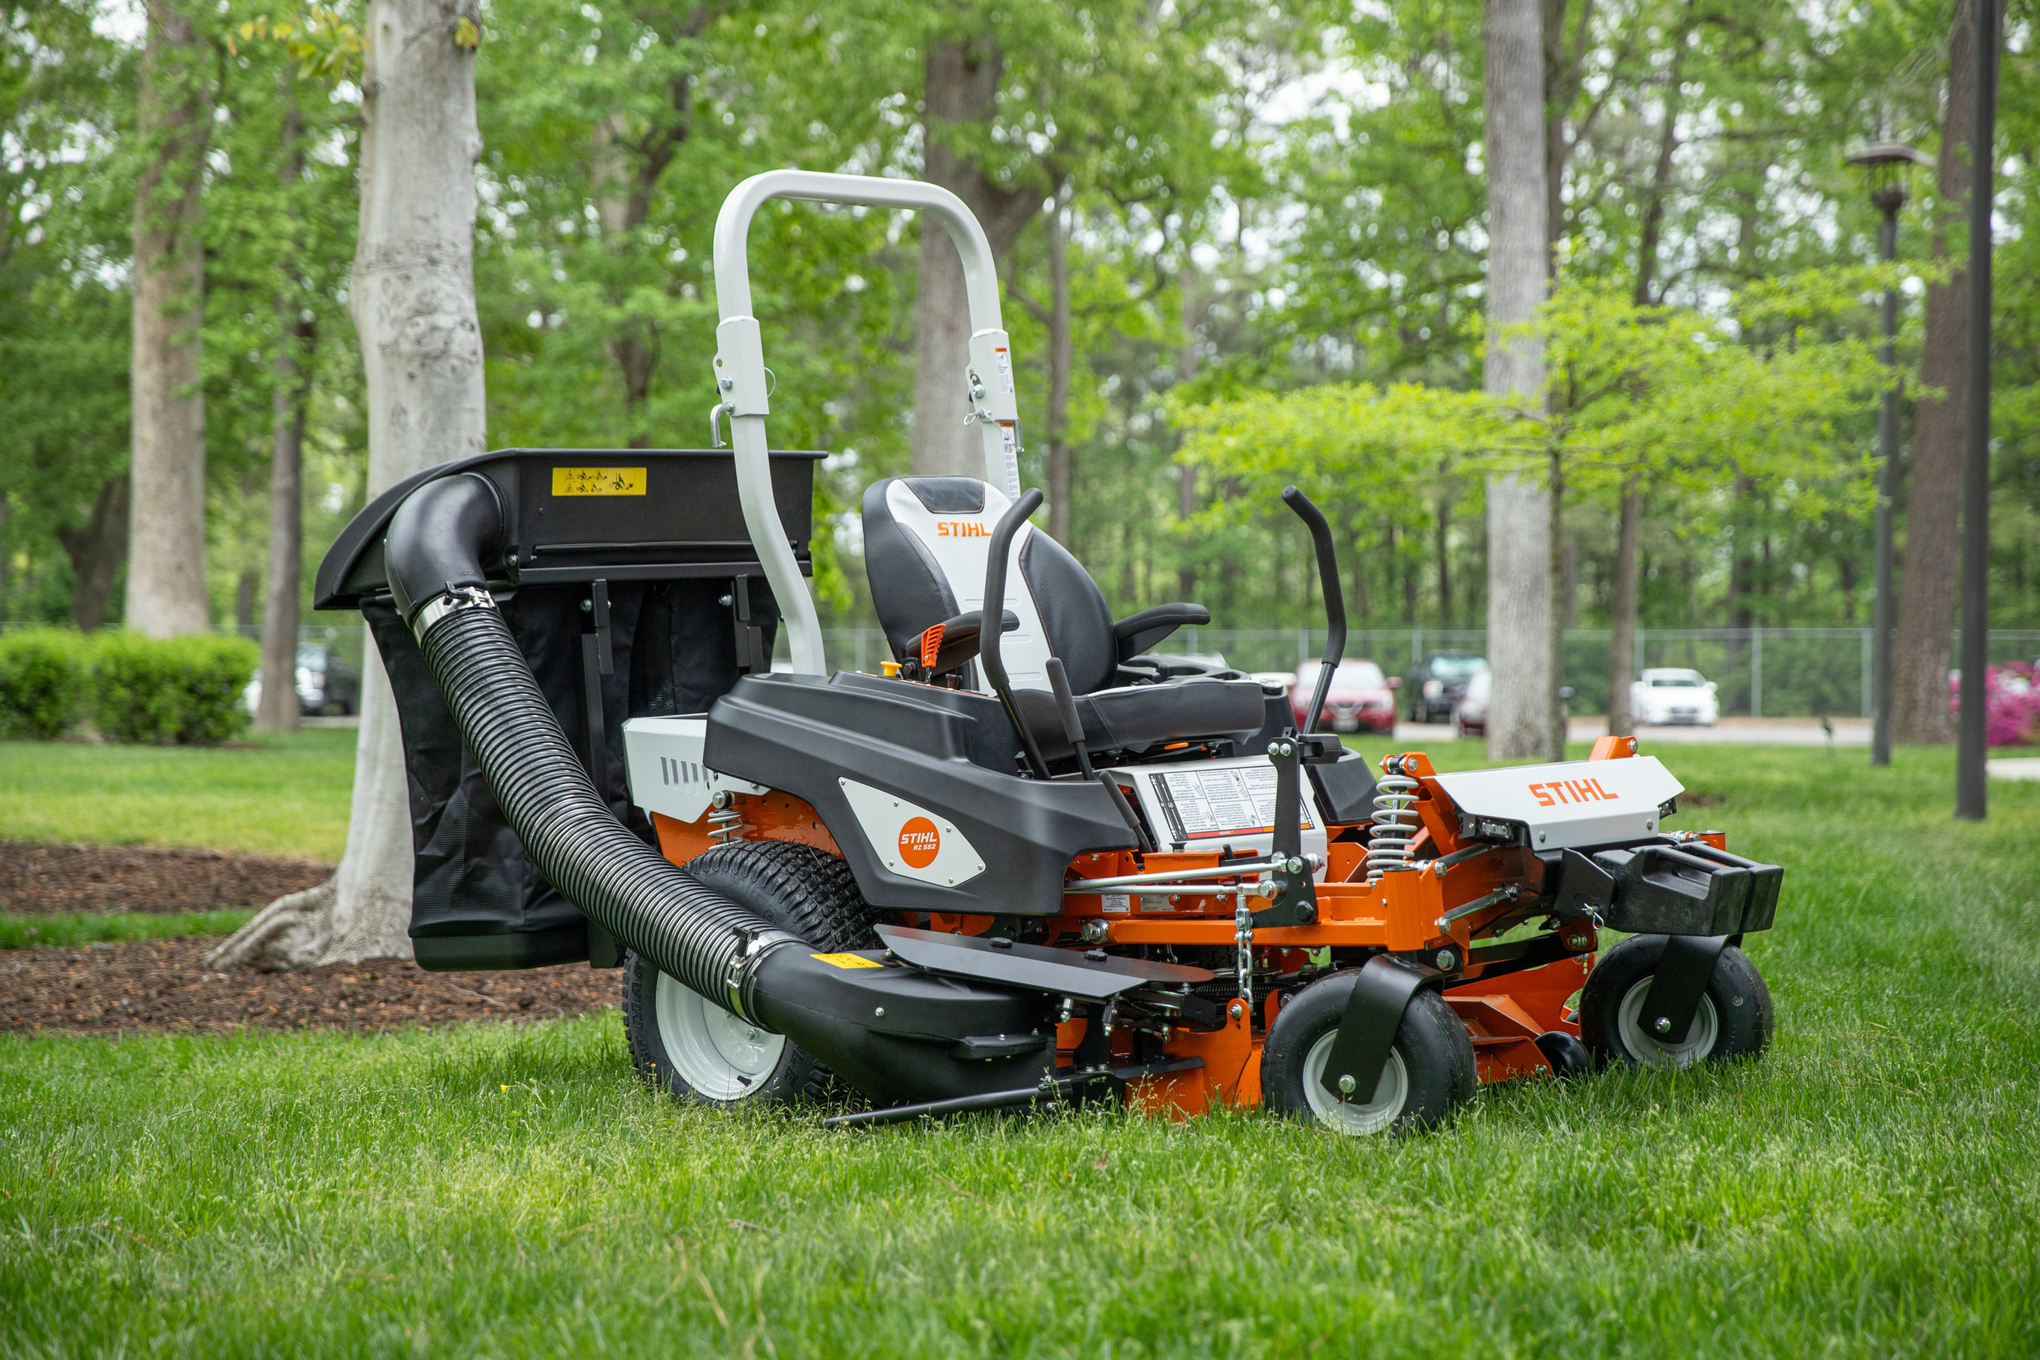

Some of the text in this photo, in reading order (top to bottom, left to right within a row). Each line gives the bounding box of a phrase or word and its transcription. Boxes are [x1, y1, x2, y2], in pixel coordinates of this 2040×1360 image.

[937, 521, 992, 537] STIHL
[1528, 778, 1619, 806] STIHL
[901, 832, 937, 844] STIHL
